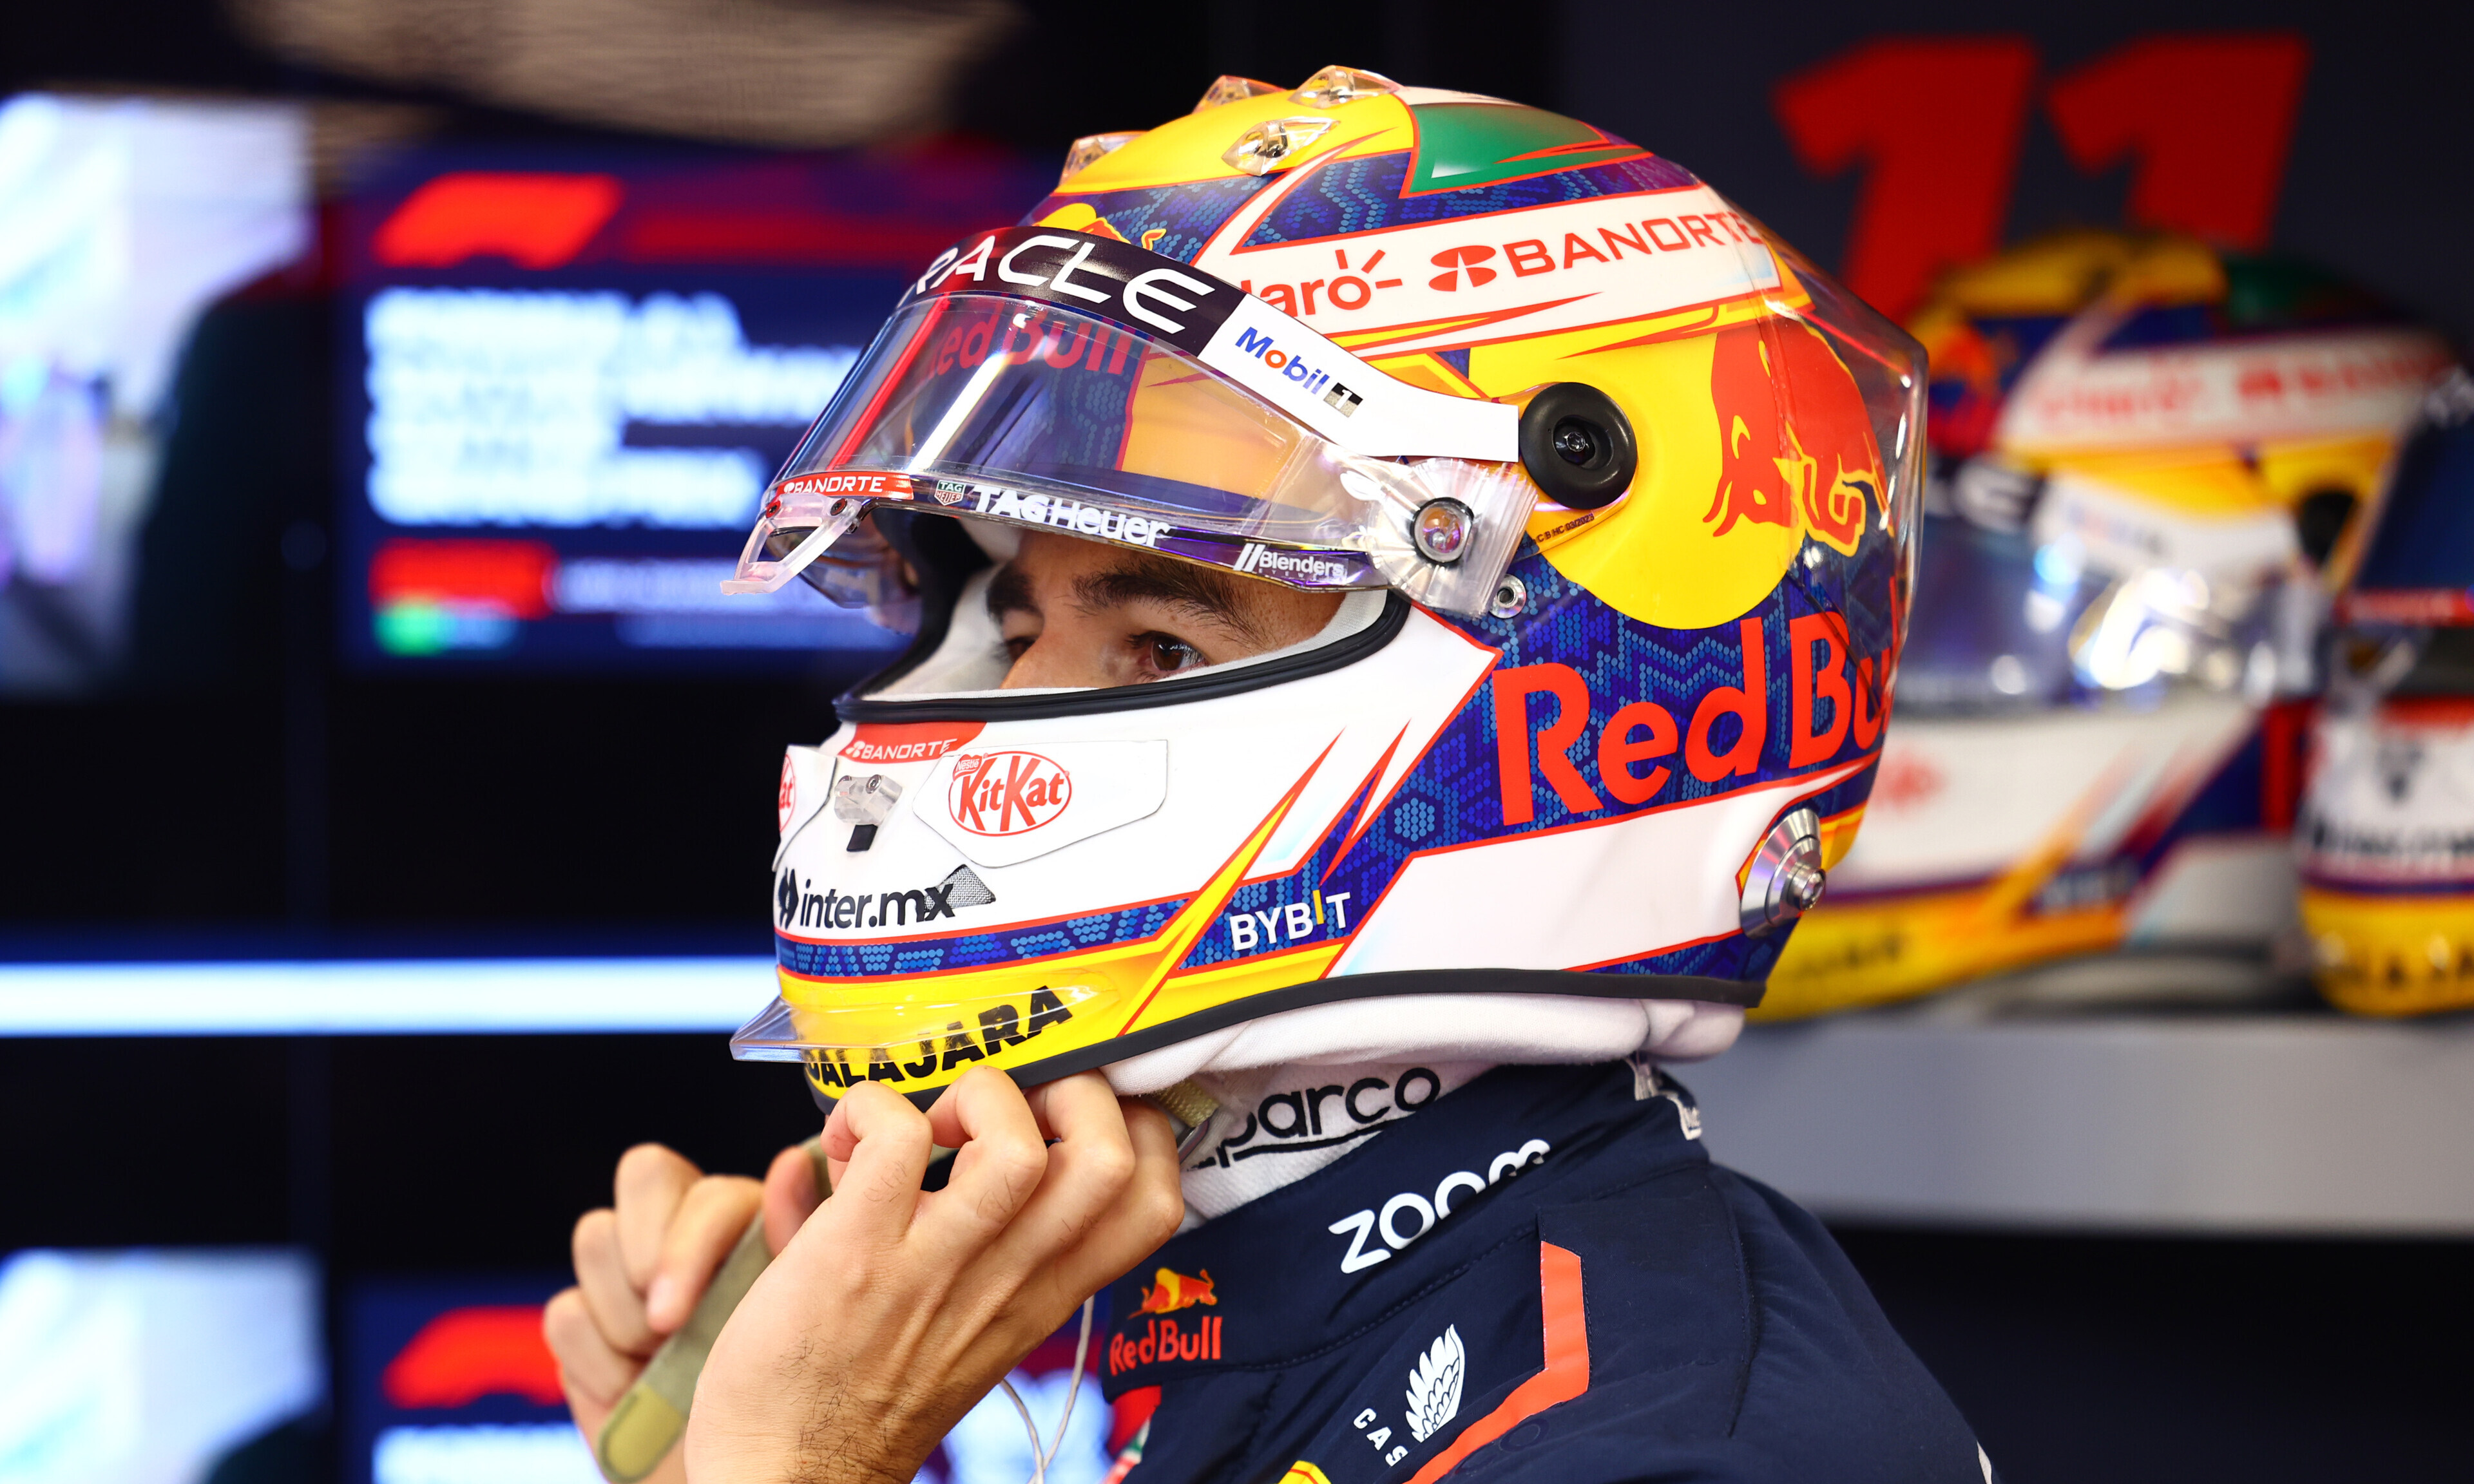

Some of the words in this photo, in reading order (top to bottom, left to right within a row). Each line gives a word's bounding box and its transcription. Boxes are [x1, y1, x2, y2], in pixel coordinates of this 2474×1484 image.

[1502, 211, 1764, 279] BANORTE
[897, 234, 1216, 334] RACLE
[1241, 276, 1371, 317] aro
[1235, 327, 1330, 395] Mobil
[795, 476, 887, 493] BANORTE
[936, 491, 961, 502] HEUER
[939, 482, 963, 492] TAG
[1259, 551, 1345, 576] Blenders
[860, 739, 958, 760] BANORTE
[1491, 618, 1767, 826] Red
[800, 879, 955, 929] inter.mx
[1229, 889, 1351, 951] BYBIT
[1216, 1067, 1441, 1168] arco
[1109, 1318, 1156, 1377] Red
[1158, 1315, 1223, 1362] Bull
